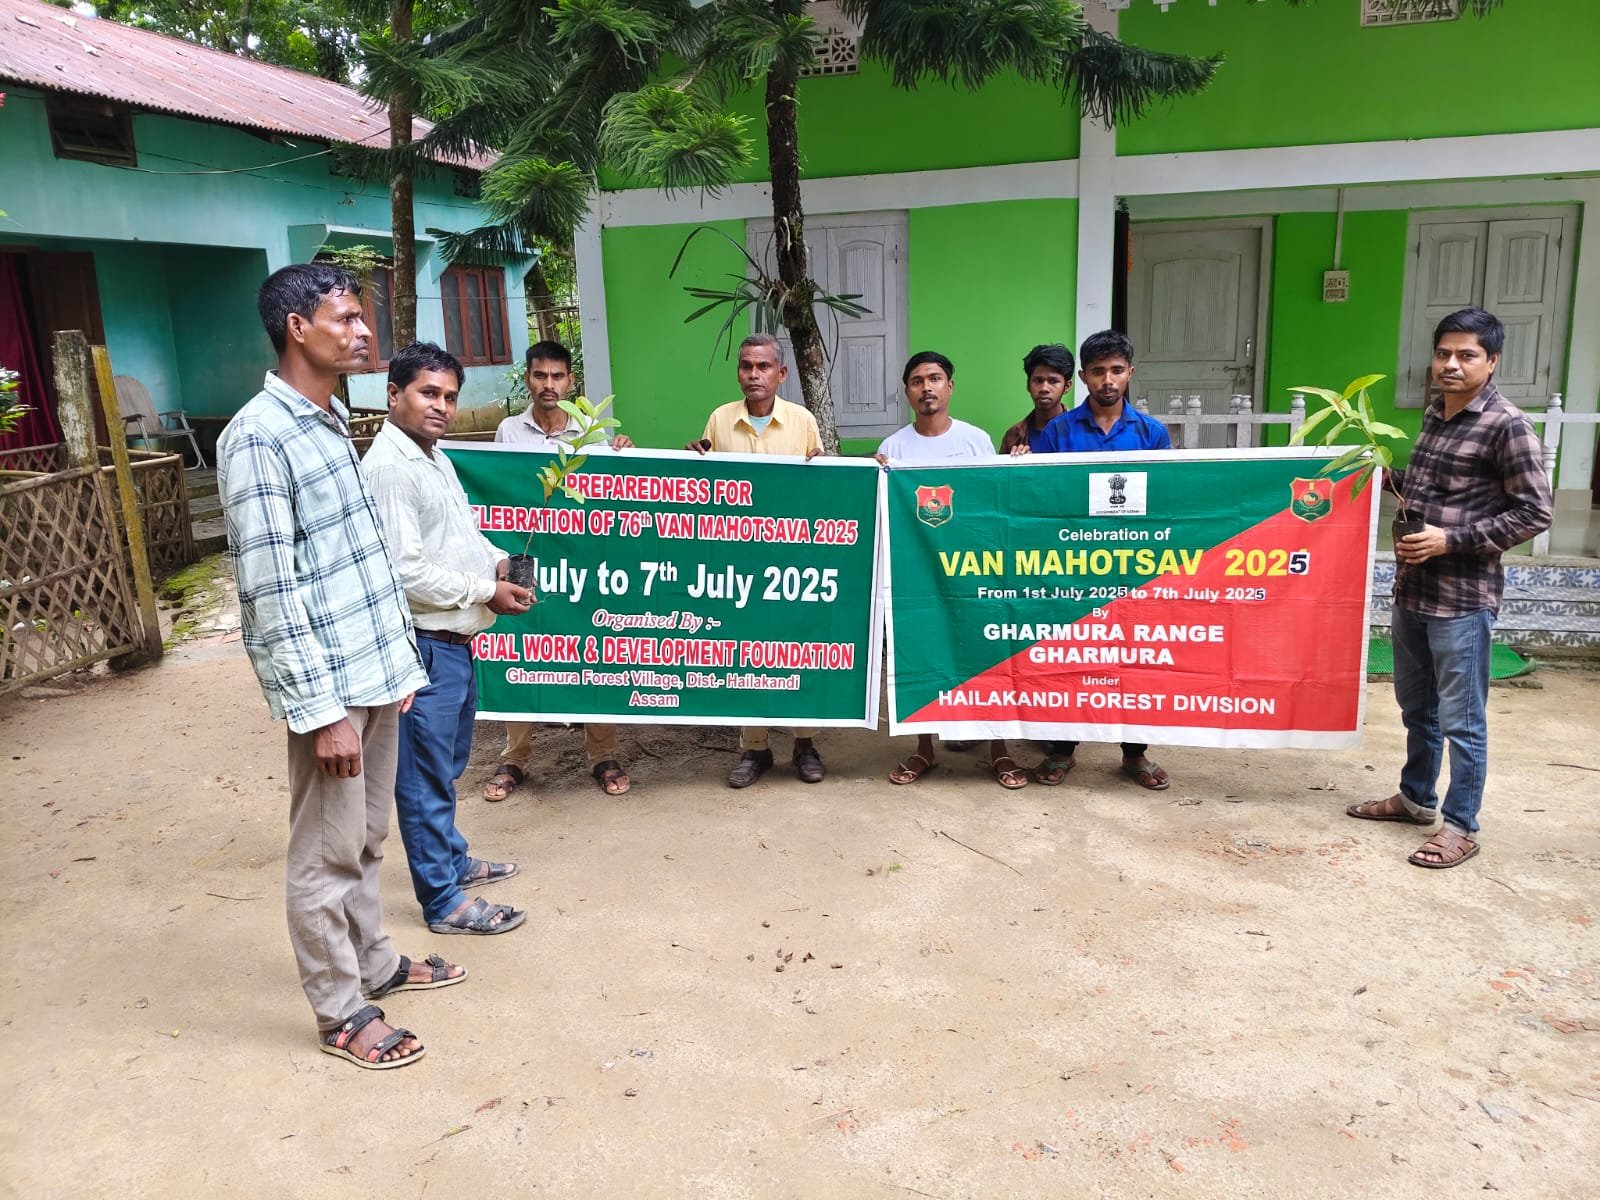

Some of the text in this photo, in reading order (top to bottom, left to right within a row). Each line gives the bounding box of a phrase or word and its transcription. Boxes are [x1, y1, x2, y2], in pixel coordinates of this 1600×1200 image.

[565, 473, 752, 505] PREPAREDNESS FOR
[470, 505, 859, 545] LEBRATION OF 76th VAN MAHOTSAVA 2025
[1059, 528, 1171, 541] Celebration of
[938, 549, 1310, 577] VAN MAHOTSAV 2025
[597, 560, 629, 595] to
[640, 561, 678, 596] 7th
[687, 563, 754, 608] July
[762, 566, 838, 602] 2025
[977, 587, 1266, 603] From 1st July 2025 to 7th July 2025
[592, 609, 677, 631] Organised
[680, 611, 703, 633] By
[1092, 608, 1109, 620] By
[983, 623, 1225, 642] GHARMURA RANGE
[523, 634, 580, 662] WORK
[584, 636, 599, 664] &
[602, 637, 737, 667] DEVELOPMENT
[739, 640, 854, 670] FOUNDATION
[1029, 647, 1175, 665] GHARMURA
[506, 668, 579, 685] Gharmura
[582, 670, 629, 687] Forest
[631, 671, 683, 690] Village,
[726, 673, 800, 690] Hailakandi
[1082, 676, 1120, 686] Under
[629, 690, 679, 708] Assam
[939, 690, 1275, 714] HAILAKANDI FOREST DIVISION
